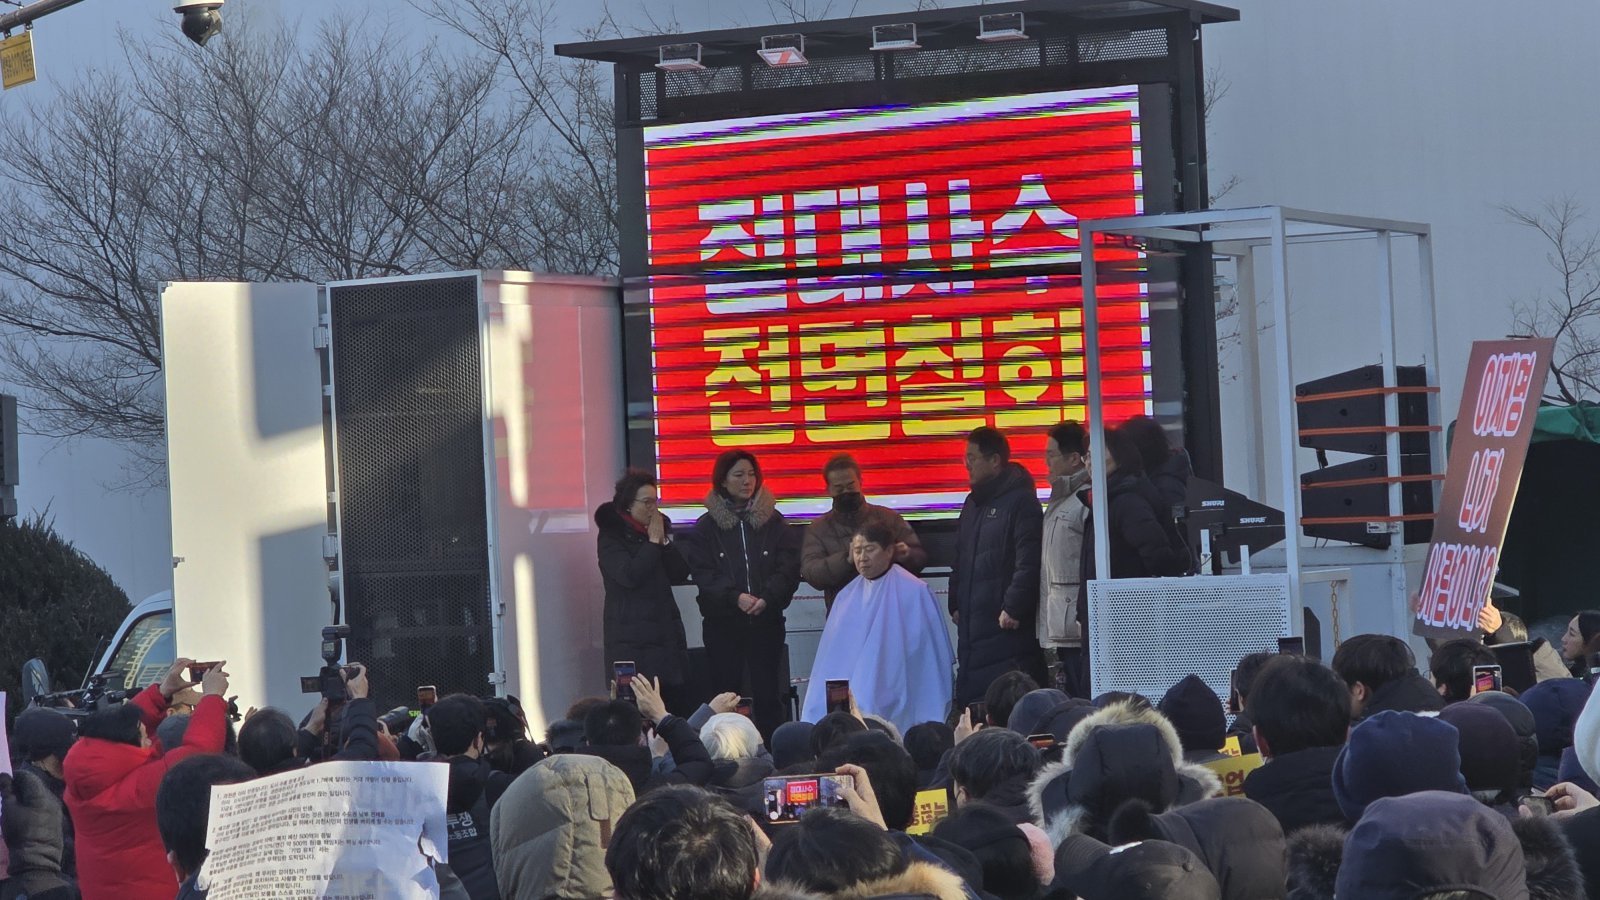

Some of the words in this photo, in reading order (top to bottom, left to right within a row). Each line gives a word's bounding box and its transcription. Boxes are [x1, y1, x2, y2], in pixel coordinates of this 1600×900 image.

[703, 308, 1085, 446] 전면철회
[1474, 351, 1537, 437] 이재명
[1458, 448, 1505, 533] 니가
[353, 776, 363, 784] 거대
[329, 790, 352, 798] 일입니다.
[447, 811, 474, 830] 투쟁
[262, 869, 277, 877] 우리만
[278, 868, 308, 876] 걷어찹니까?
[253, 883, 274, 891] 자산이기
[275, 882, 303, 890] 때문입니다.
